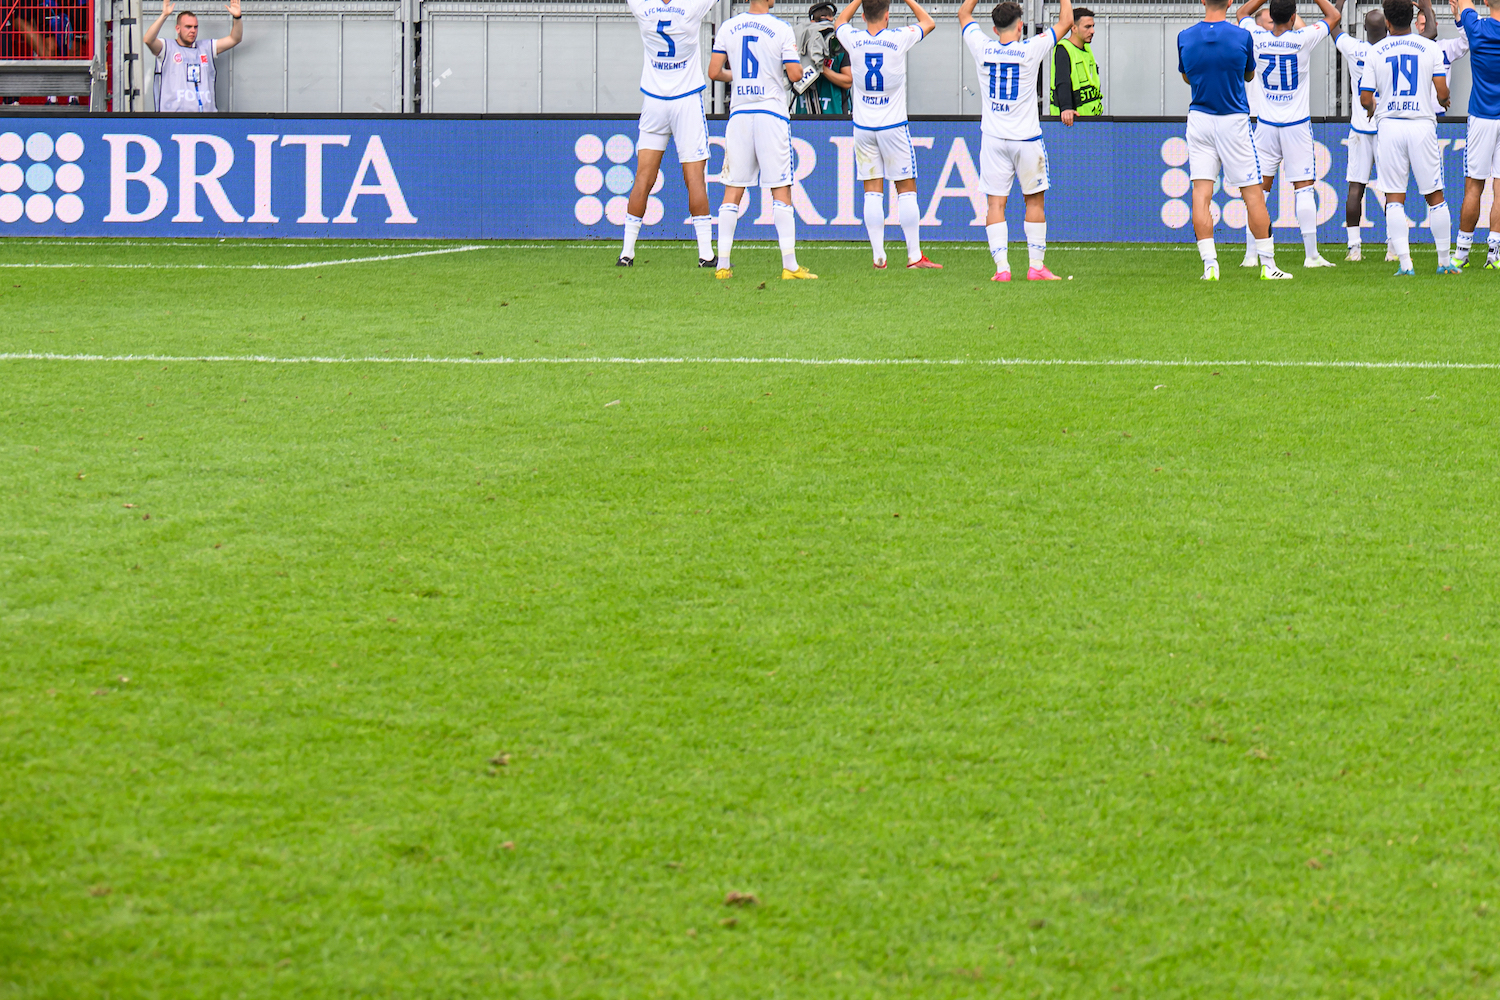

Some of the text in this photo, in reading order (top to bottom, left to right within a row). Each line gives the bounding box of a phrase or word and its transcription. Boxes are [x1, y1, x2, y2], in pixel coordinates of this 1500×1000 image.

[656, 19, 676, 58] 5
[741, 35, 759, 79] 6
[864, 52, 884, 92] 8
[983, 61, 1020, 101] 10
[1258, 53, 1299, 91] 20
[1385, 53, 1419, 97] 19
[1402, 101, 1420, 111] BELL
[103, 134, 418, 224] BRITA
